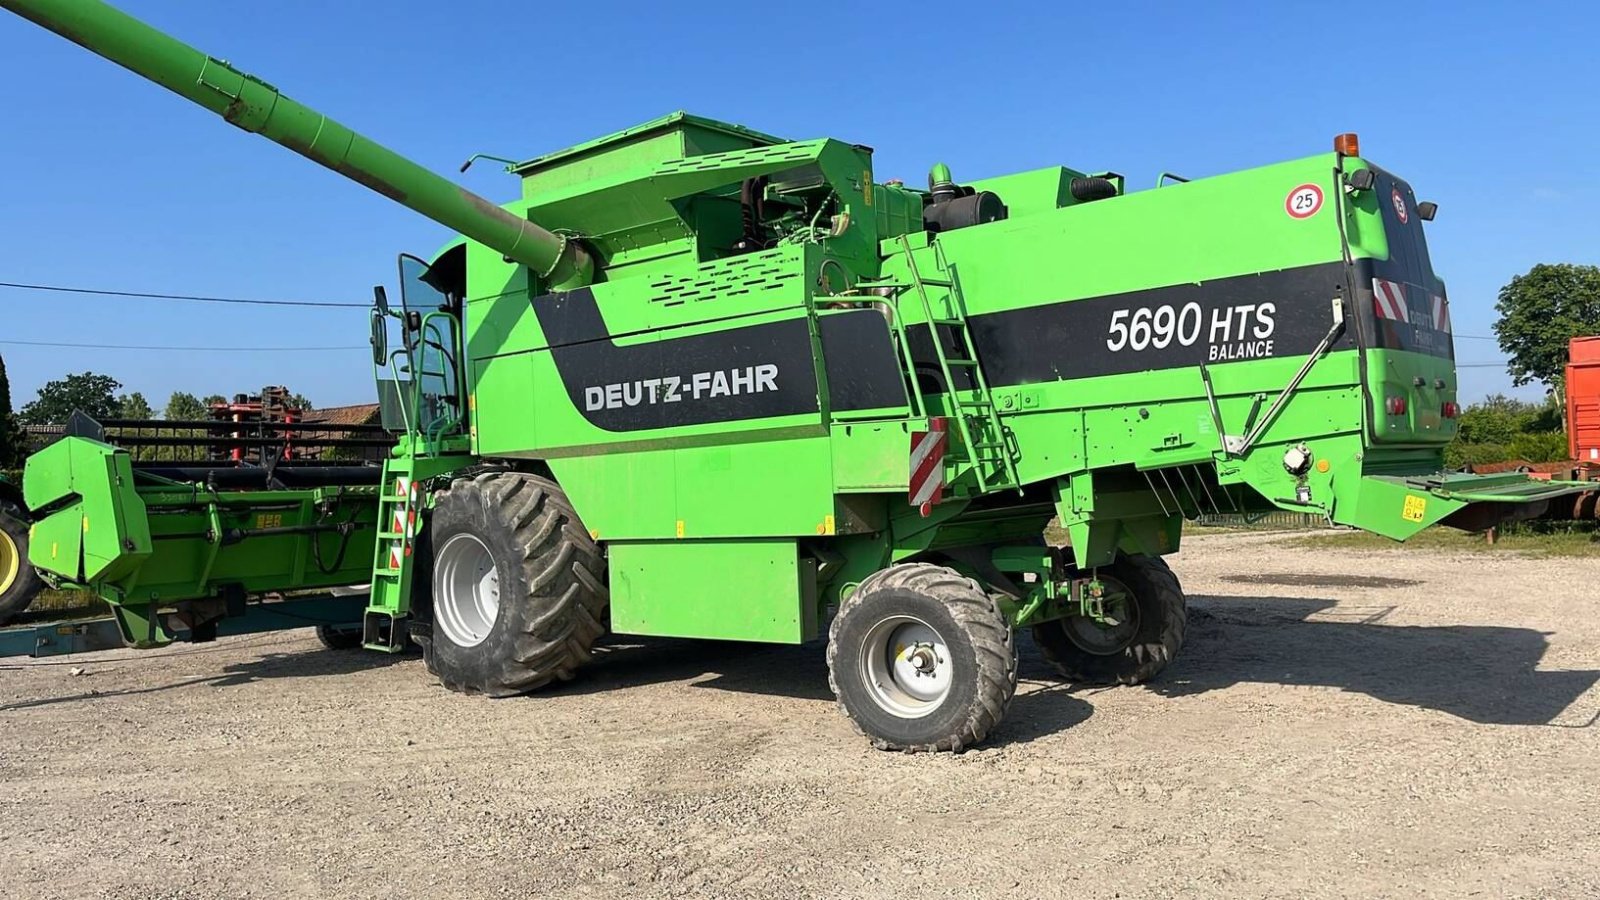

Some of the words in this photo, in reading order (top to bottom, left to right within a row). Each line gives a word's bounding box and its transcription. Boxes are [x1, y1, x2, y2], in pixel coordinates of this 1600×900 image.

[1296, 193, 1313, 210] 25
[1106, 301, 1202, 352] 5690
[1209, 302, 1276, 343] HTS
[1209, 340, 1274, 361] BALANCE
[585, 364, 779, 411] DEUTZ-FAHR
